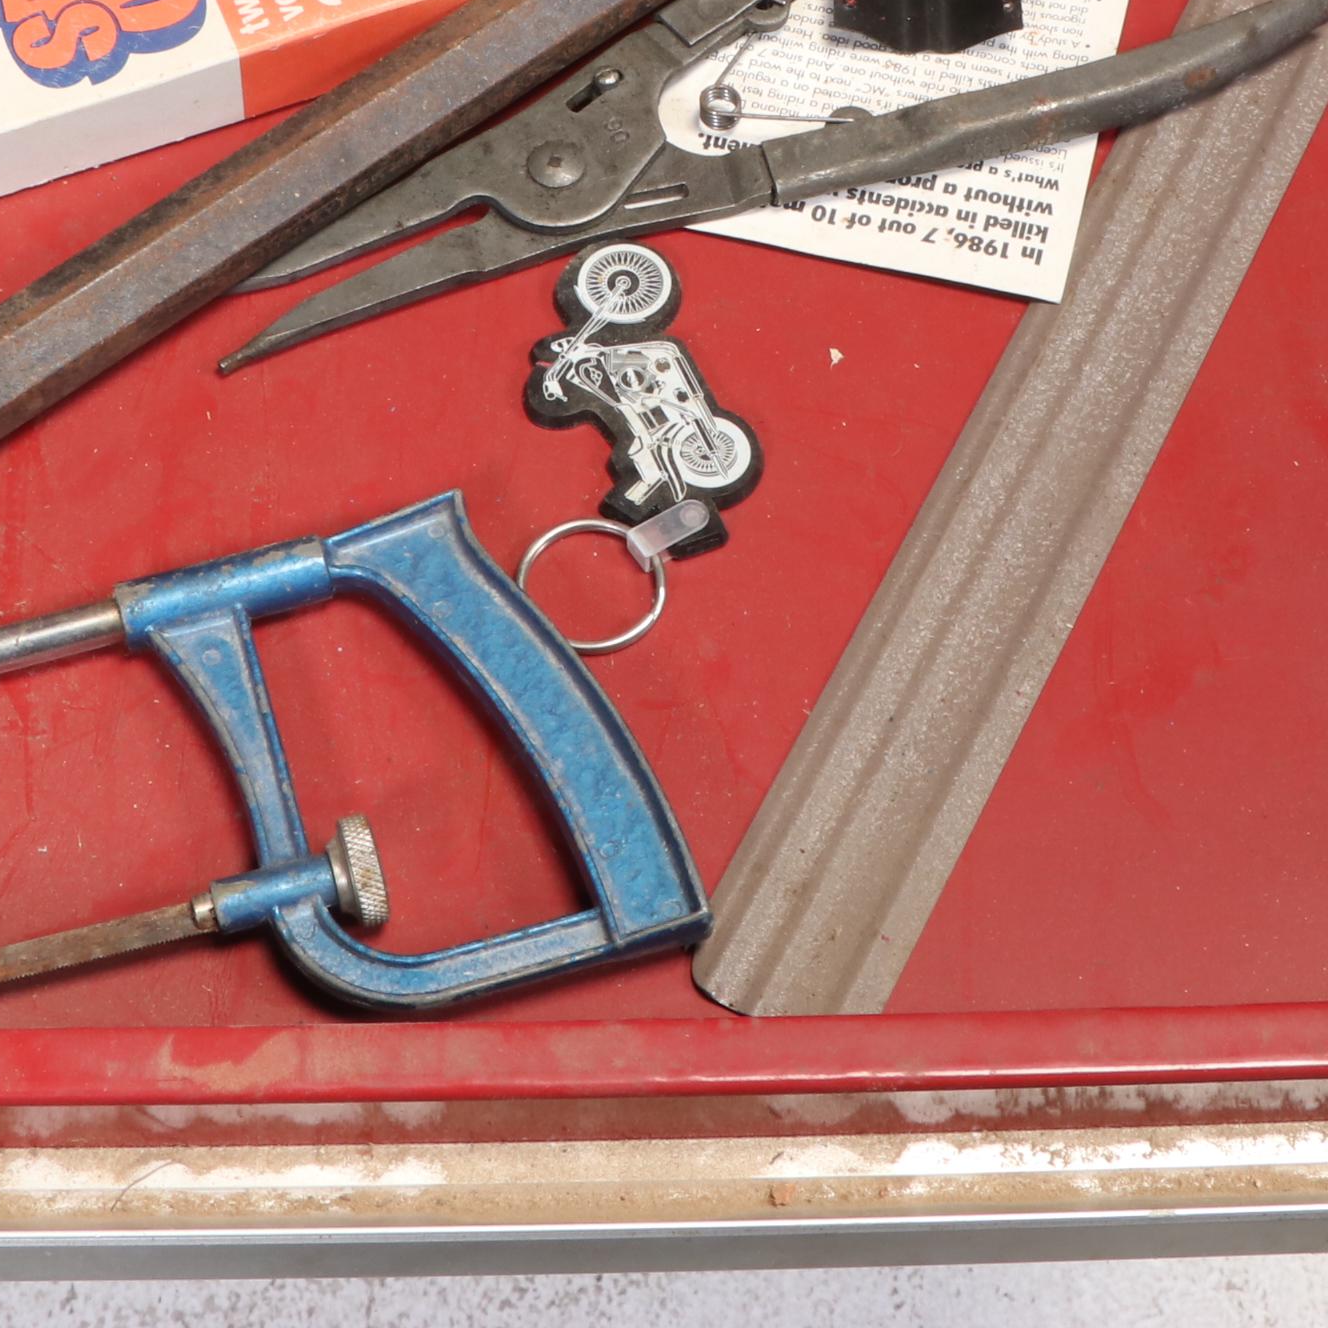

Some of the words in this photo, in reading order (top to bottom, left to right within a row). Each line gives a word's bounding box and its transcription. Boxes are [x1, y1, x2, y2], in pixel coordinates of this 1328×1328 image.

[757, 32, 803, 48] without
[807, 41, 846, 58] riding
[997, 41, 1017, 55] the
[1021, 48, 1048, 58] with
[770, 48, 803, 63] since
[849, 52, 880, 65] were
[920, 53, 931, 62] a
[933, 56, 950, 68] be
[1051, 49, 1089, 67] along
[747, 57, 781, 71] word
[805, 57, 832, 71] And
[953, 59, 967, 70] to
[970, 63, 1003, 76] seem
[785, 65, 805, 78] the
[808, 71, 821, 82] to
[868, 70, 915, 86] without
[922, 68, 936, 79] in
[937, 70, 973, 87] killed
[779, 78, 789, 88] a
[795, 82, 810, 92] on
[824, 75, 851, 87] next
[919, 80, 945, 93] ride
[766, 88, 805, 106] riding
[812, 86, 872, 104] indicated
[808, 98, 818, 108] a
[875, 98, 892, 109] it's
[1002, 150, 1044, 166] issued
[987, 165, 998, 175] a
[1048, 160, 1065, 174] It's
[1004, 169, 1059, 191] What's
[941, 181, 958, 195] a
[846, 187, 948, 217] accidents
[963, 187, 1052, 216] without
[810, 204, 837, 225] 10
[845, 211, 872, 229] of
[955, 208, 978, 229] in
[877, 217, 916, 234] out
[982, 214, 1048, 243] killed
[920, 226, 938, 244] 7
[947, 227, 1009, 259] 1986,
[1020, 245, 1043, 265] In
